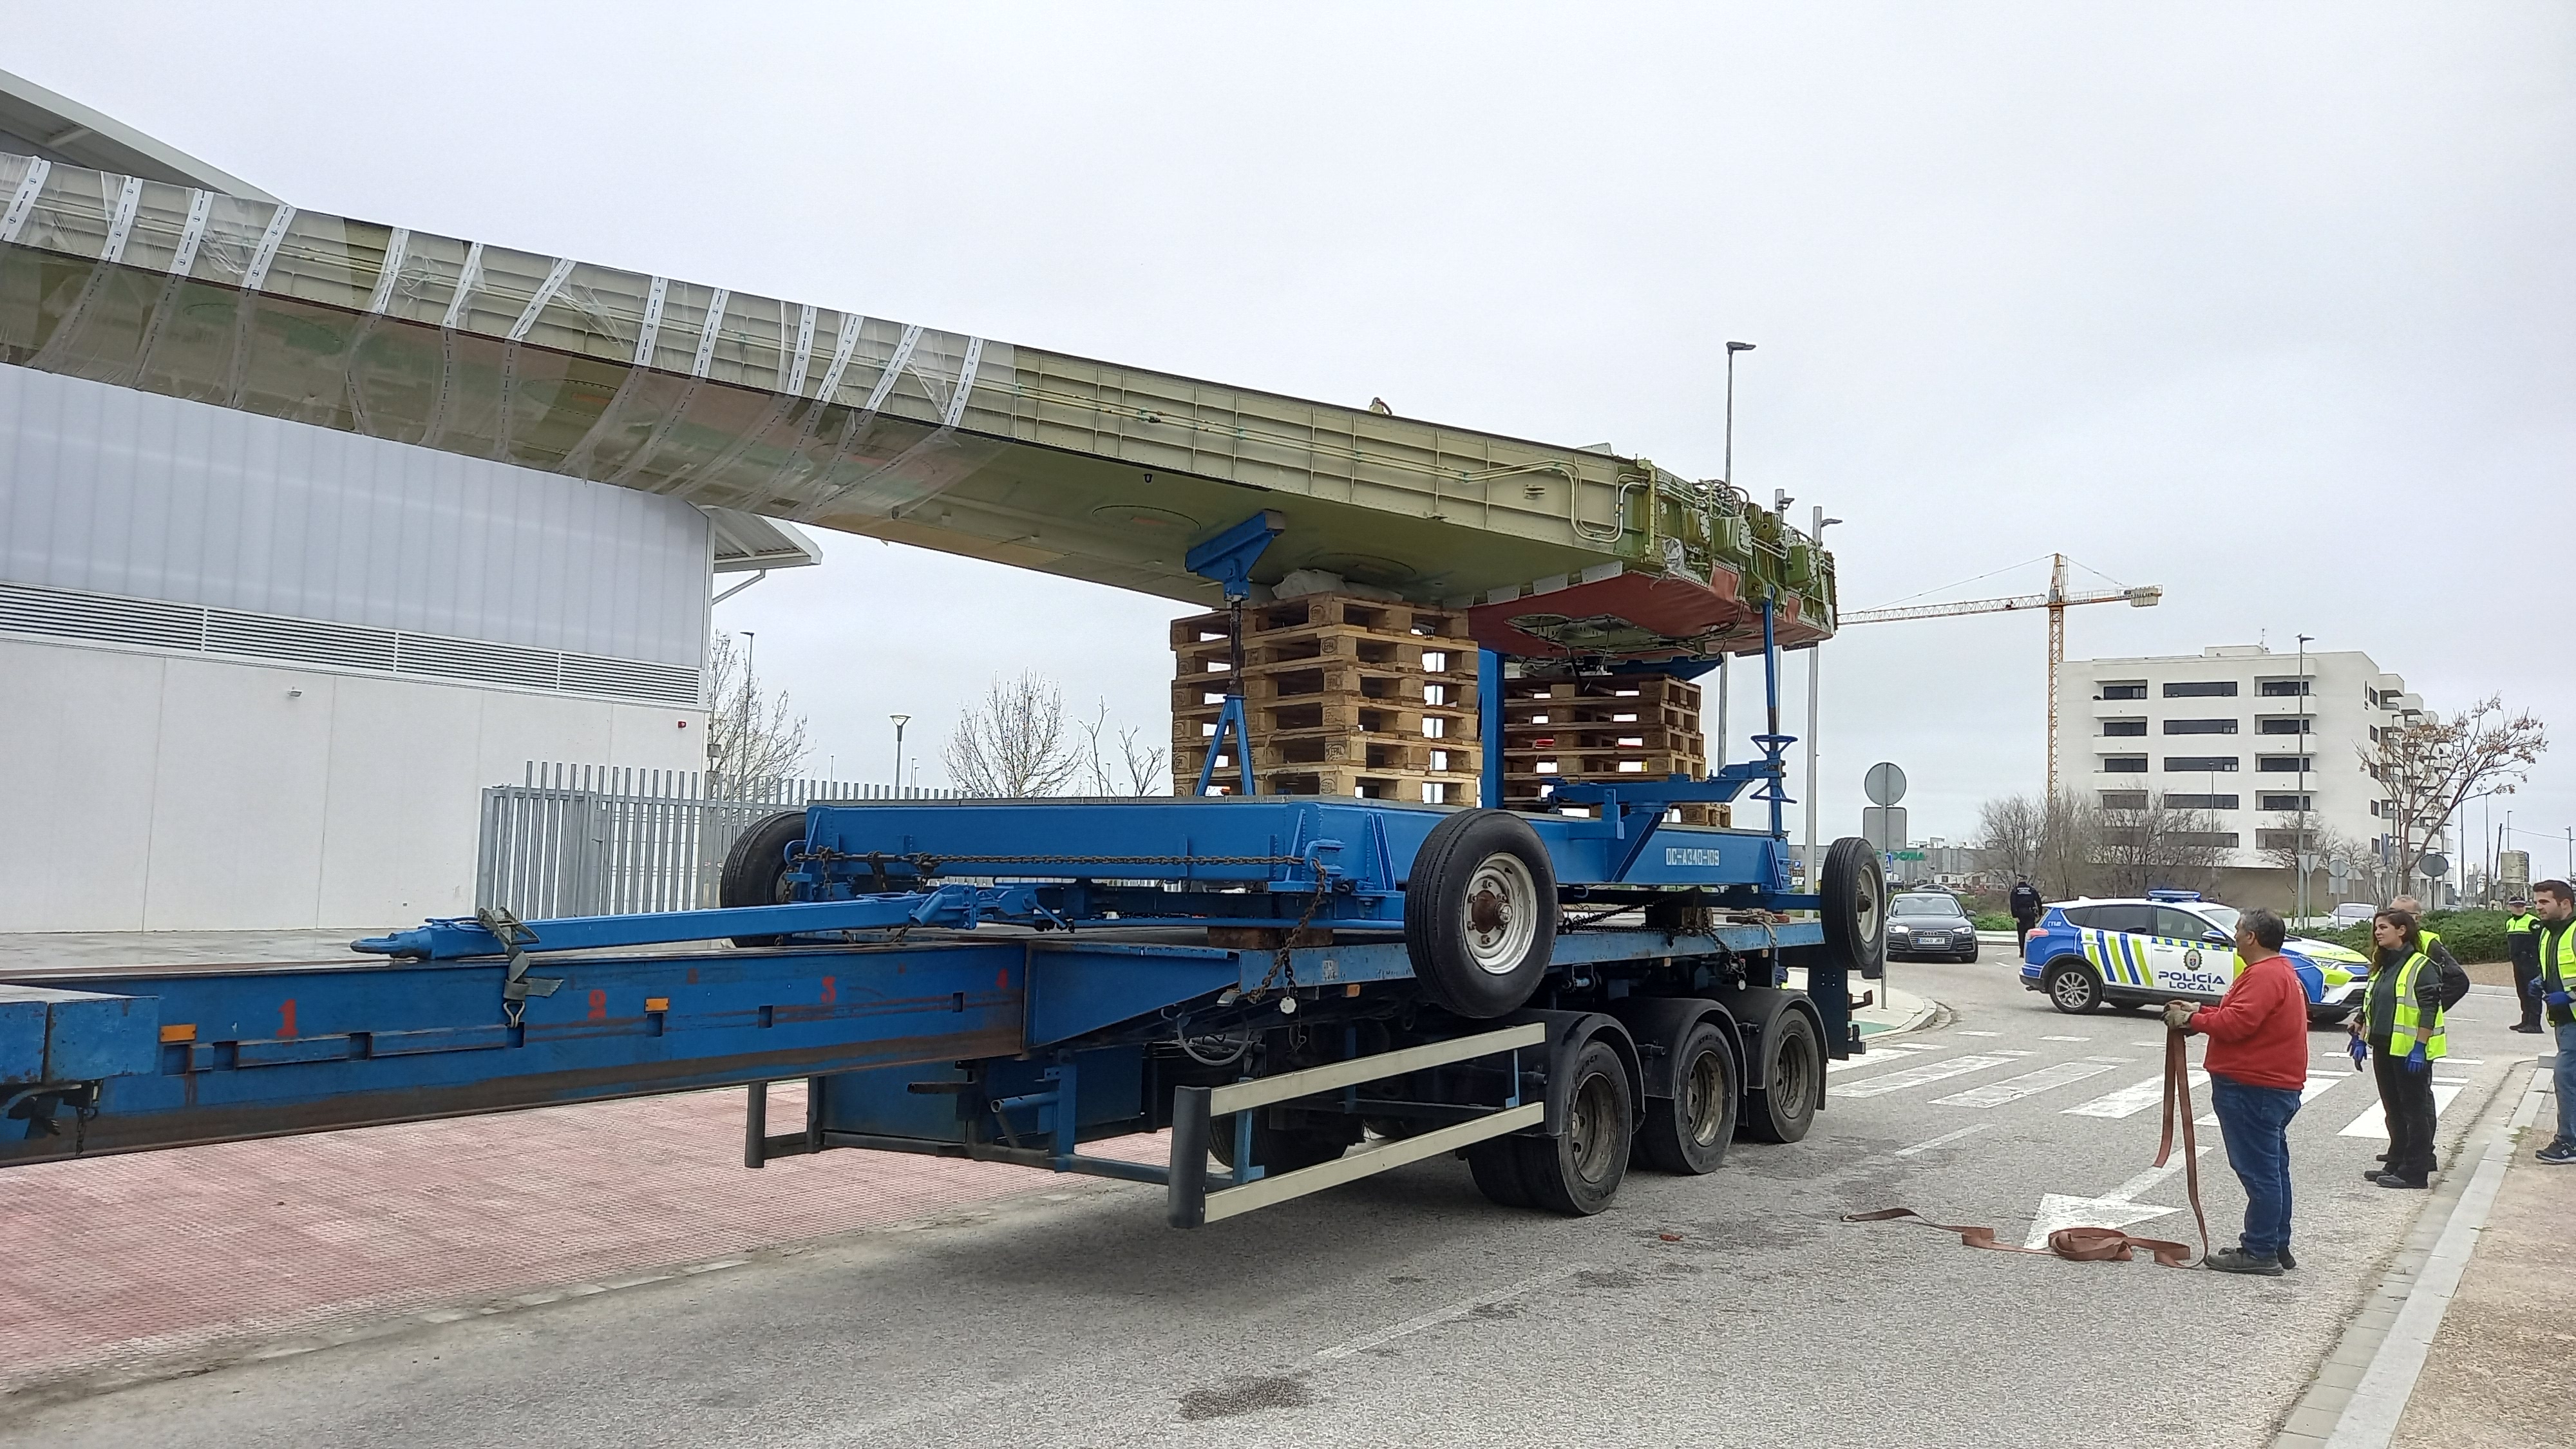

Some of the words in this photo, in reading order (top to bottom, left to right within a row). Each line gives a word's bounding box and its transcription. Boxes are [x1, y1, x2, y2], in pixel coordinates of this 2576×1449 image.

[2158, 971, 2226, 985] POLICÍA
[2169, 981, 2215, 992] LOCAL
[276, 998, 299, 1038] 1
